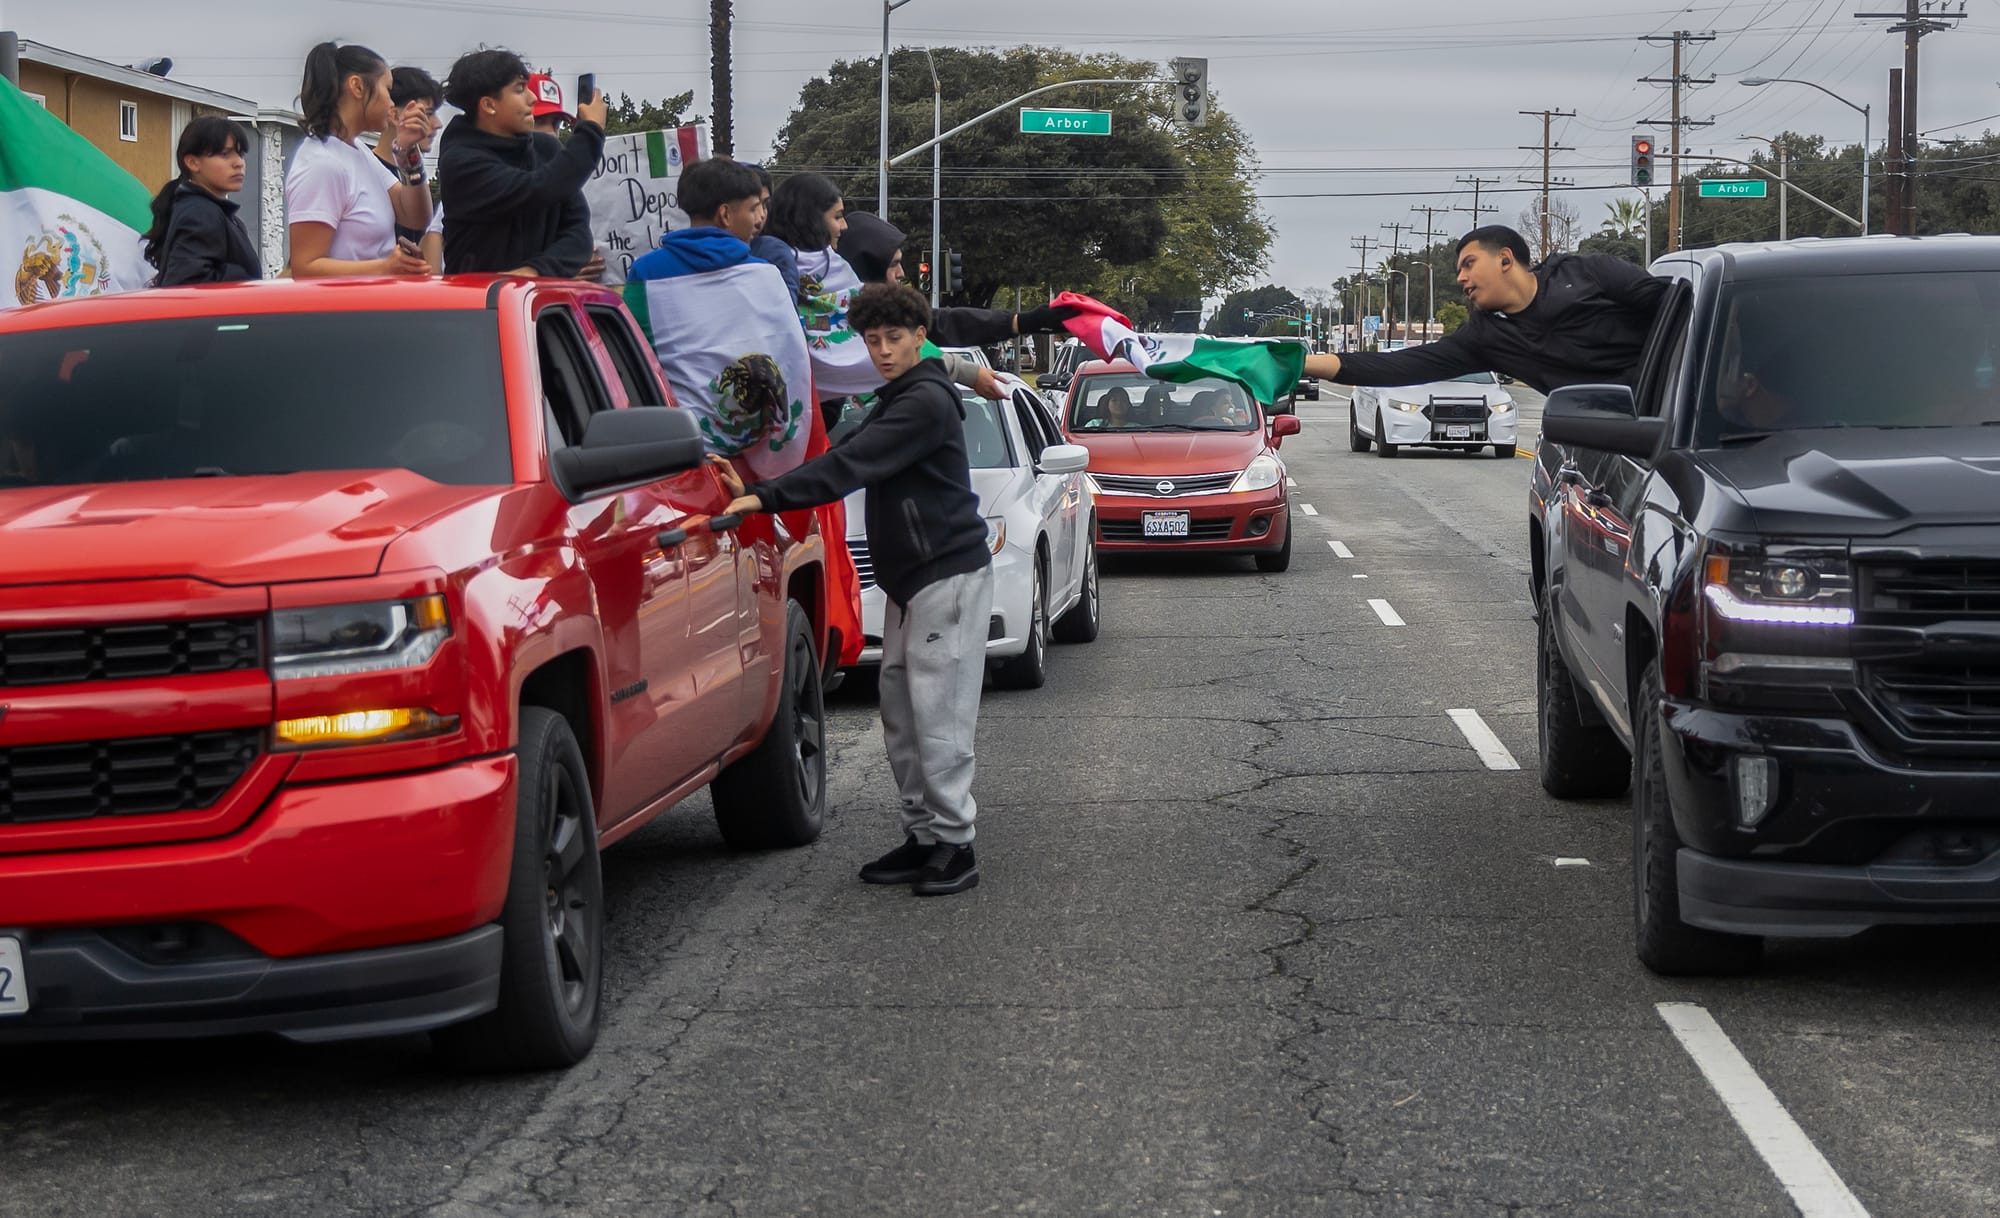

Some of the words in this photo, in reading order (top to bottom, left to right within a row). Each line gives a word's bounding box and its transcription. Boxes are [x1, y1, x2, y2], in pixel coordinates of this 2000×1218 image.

[1045, 117, 1088, 129] Arbor
[593, 136, 642, 180] Don't
[1718, 184, 1750, 193] Arbor
[606, 229, 636, 251] the
